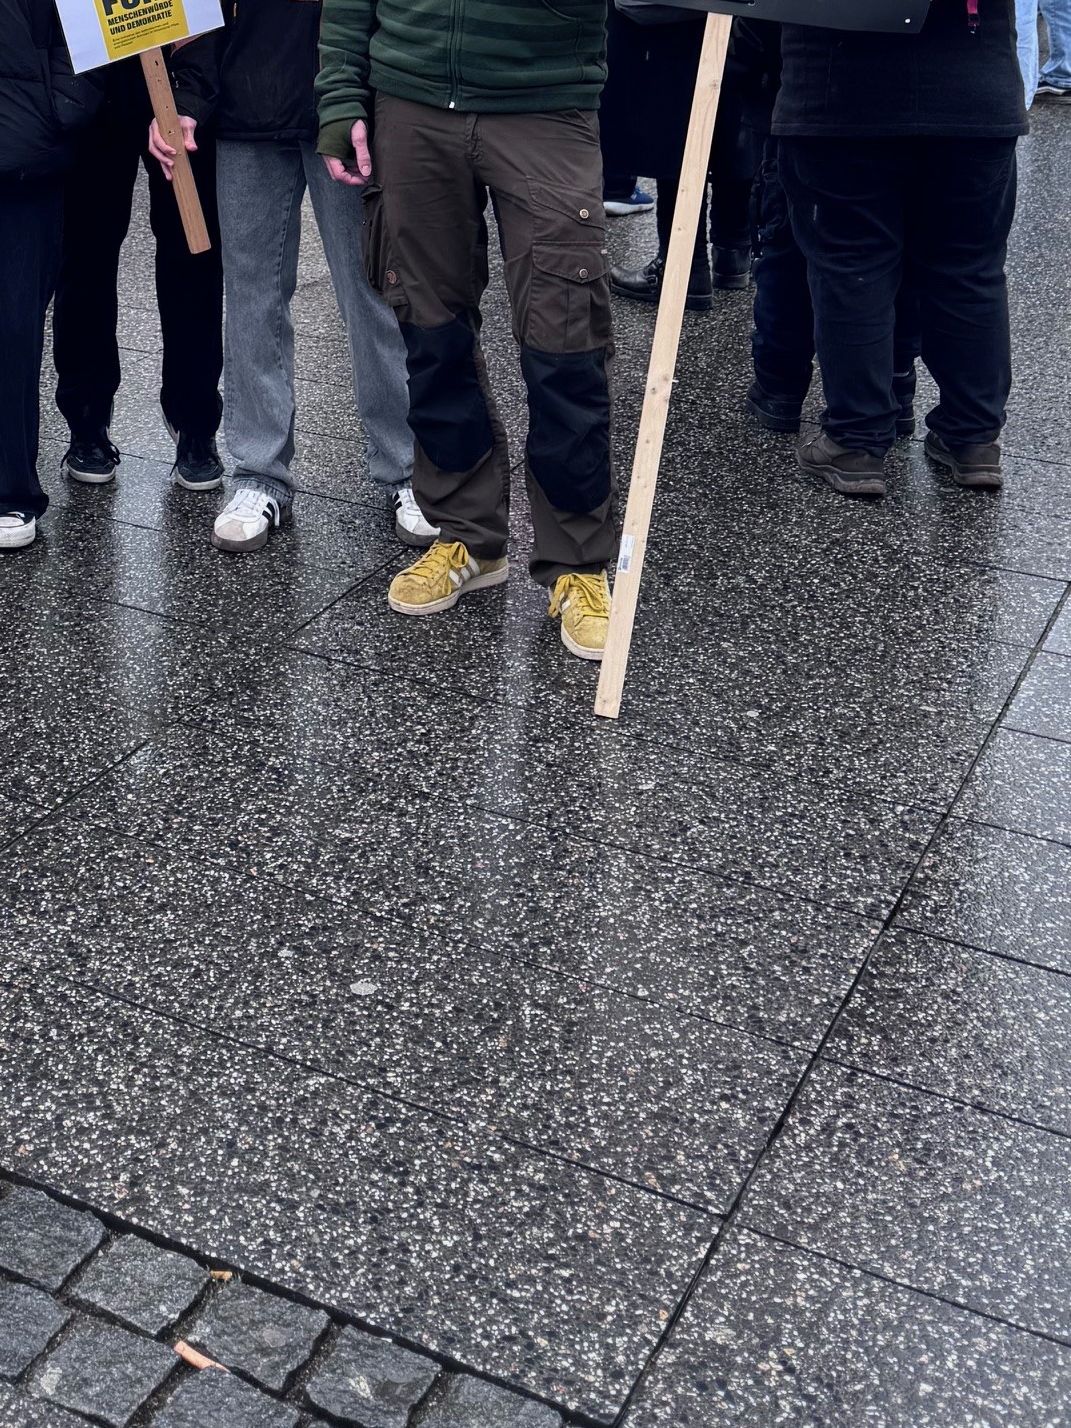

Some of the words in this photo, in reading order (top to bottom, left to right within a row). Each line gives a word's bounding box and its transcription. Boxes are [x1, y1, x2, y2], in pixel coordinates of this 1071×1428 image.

[107, 0, 174, 26] MENSCHENWÜRDE
[110, 23, 126, 36] UND
[126, 9, 173, 30] DEMOKRATIE
